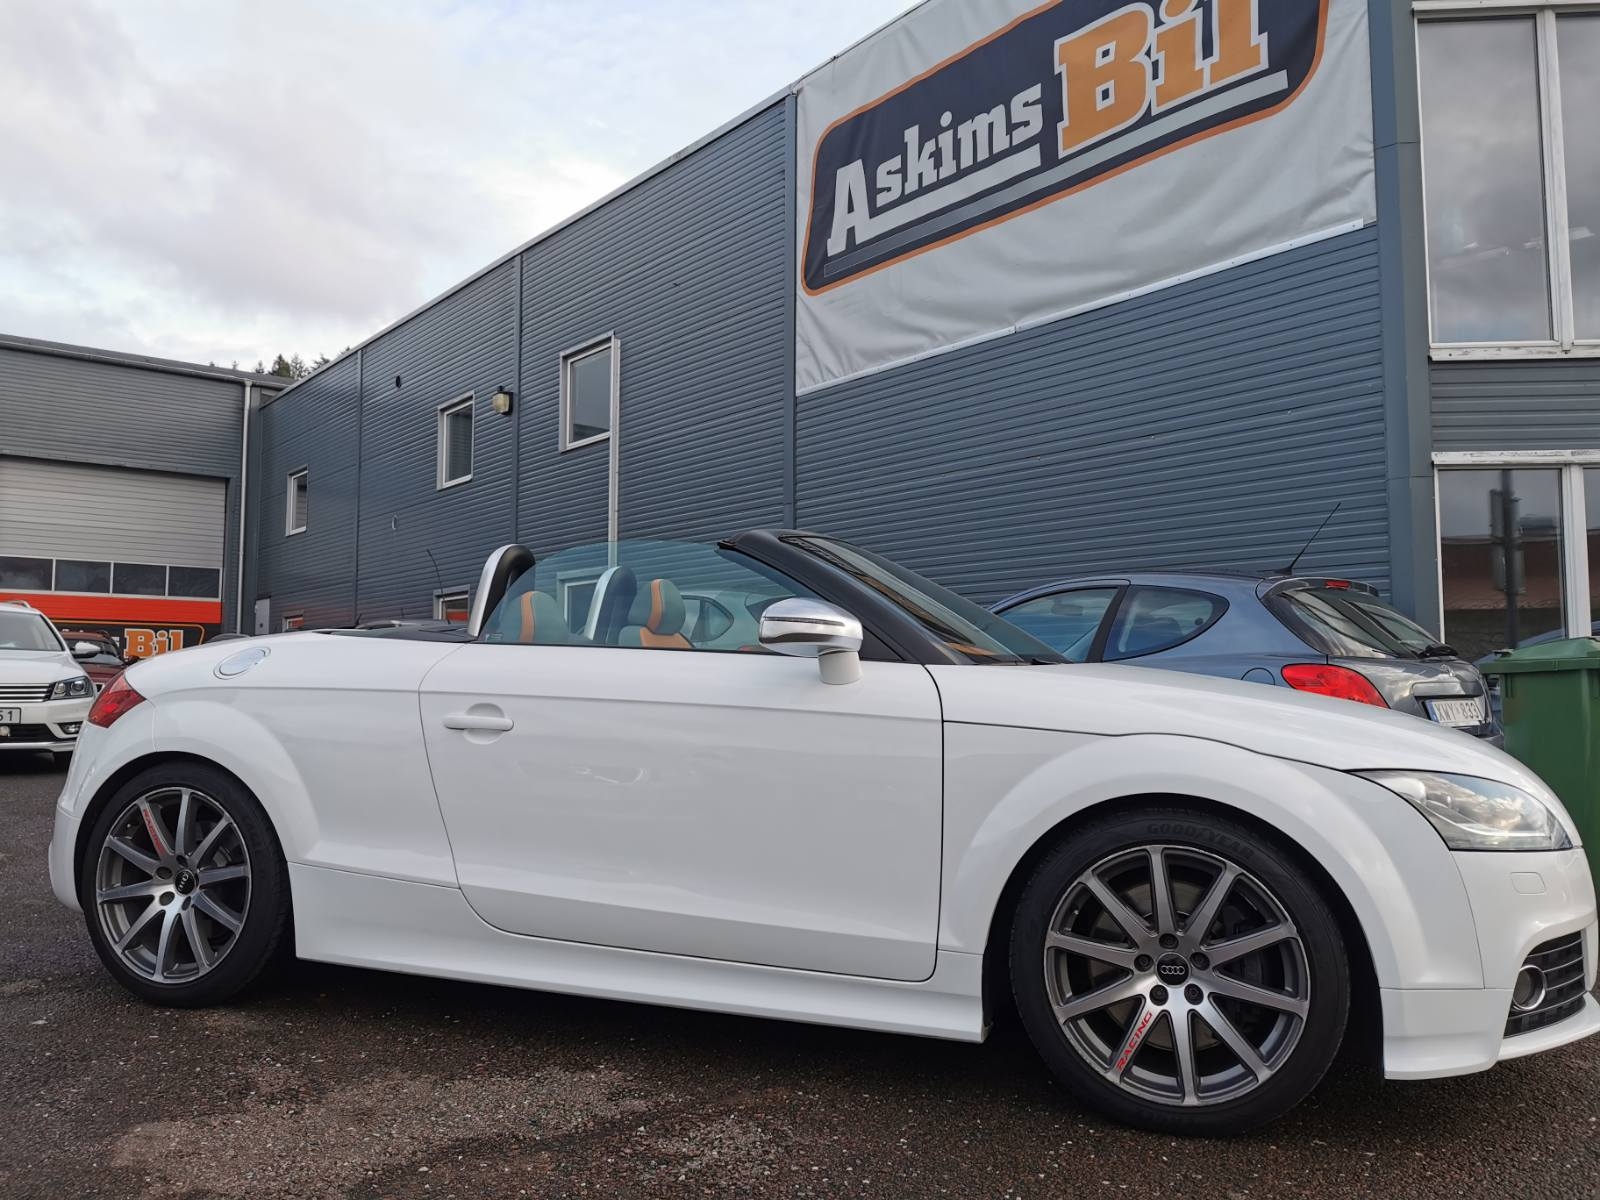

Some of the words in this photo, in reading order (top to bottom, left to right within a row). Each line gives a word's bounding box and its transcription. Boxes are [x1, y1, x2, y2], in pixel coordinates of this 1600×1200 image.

[827, 82, 1043, 257] Askims
[1054, 0, 1269, 159] Bil
[124, 628, 184, 659] Bil
[1147, 823, 1255, 859] GOODYEAR
[1116, 1010, 1153, 1073] RACING
